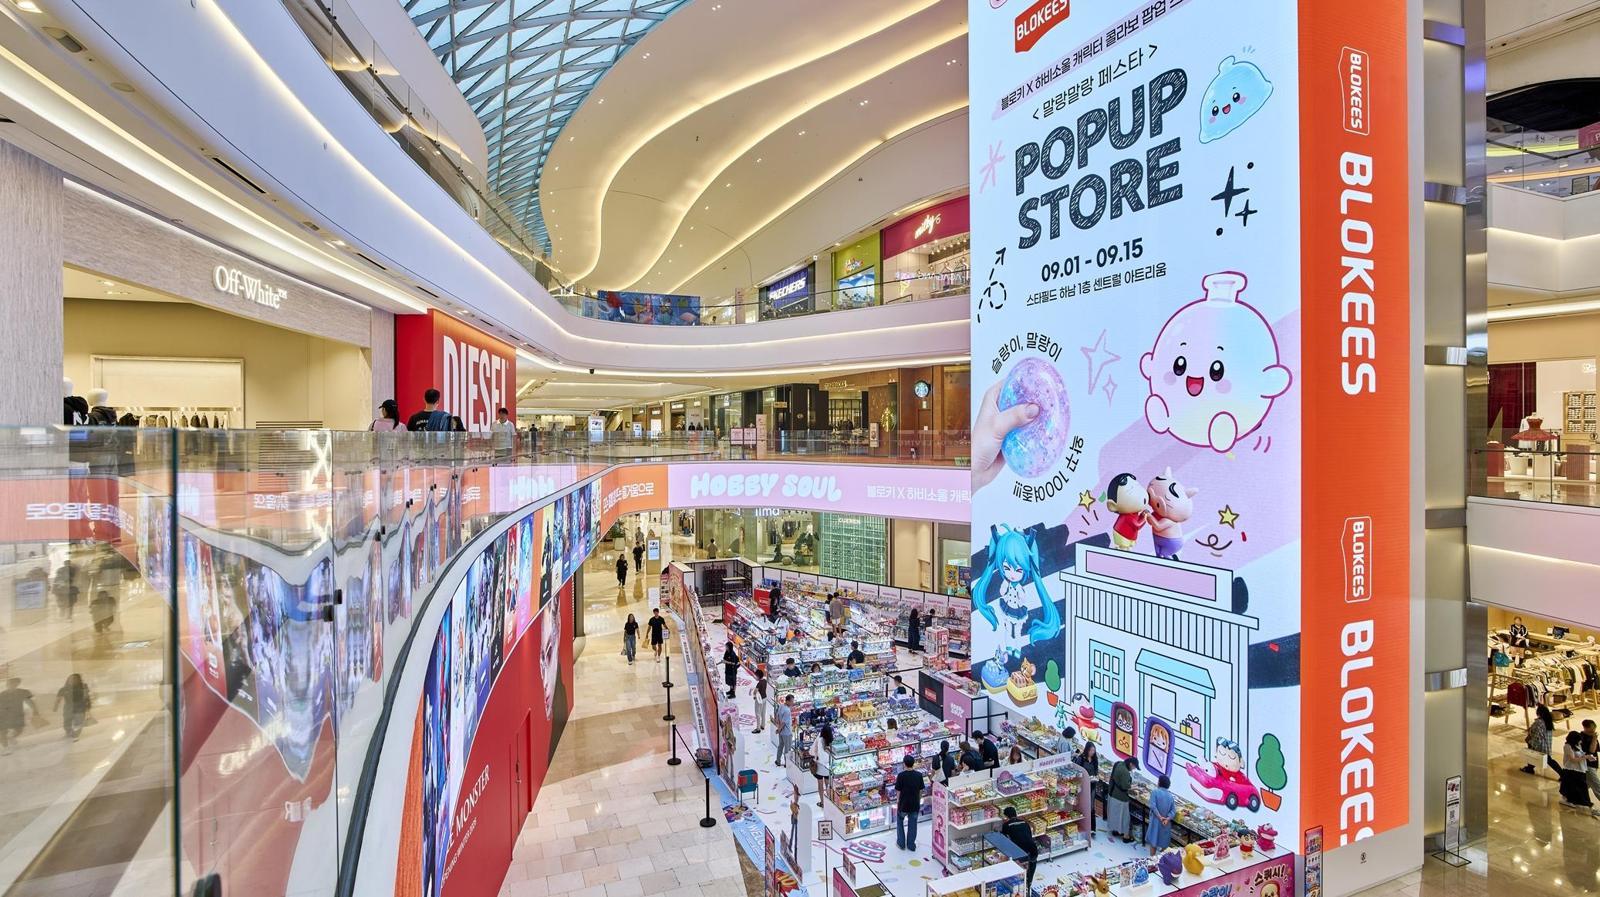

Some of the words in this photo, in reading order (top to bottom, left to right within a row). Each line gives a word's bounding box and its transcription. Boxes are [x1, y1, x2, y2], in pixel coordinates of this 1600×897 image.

[1001, 86, 1025, 110] 블로키
[1026, 81, 1033, 96] X
[1035, 57, 1071, 89] 하비소울
[1073, 37, 1103, 67] 캐릭터
[1106, 15, 1139, 47] 콜라보
[1142, 1, 1167, 25] 팝업
[1016, 0, 1068, 41] BLOKEES
[1043, 76, 1094, 117] 말랑말랑
[1098, 48, 1144, 88] 페스타
[1349, 52, 1363, 129] BLOKEES
[1015, 68, 1188, 196] POPUP
[1018, 137, 1183, 249] STORE
[1026, 289, 1057, 306] 스타필드
[1059, 284, 1076, 299] 하남
[1078, 281, 1091, 295] 1층
[1093, 273, 1121, 291] 센트럴
[1124, 262, 1167, 284] 아트리움
[1041, 255, 1080, 282] 09.01
[1096, 237, 1143, 268] 09.15
[1339, 151, 1376, 395] BLOKEES
[443, 335, 507, 432] DIESEL
[1026, 332, 1063, 362] 말랑이
[690, 472, 779, 500] HOBBY
[781, 473, 842, 502] SOUL
[1351, 520, 1365, 598] BLOKEES
[455, 764, 491, 837] MONSTER
